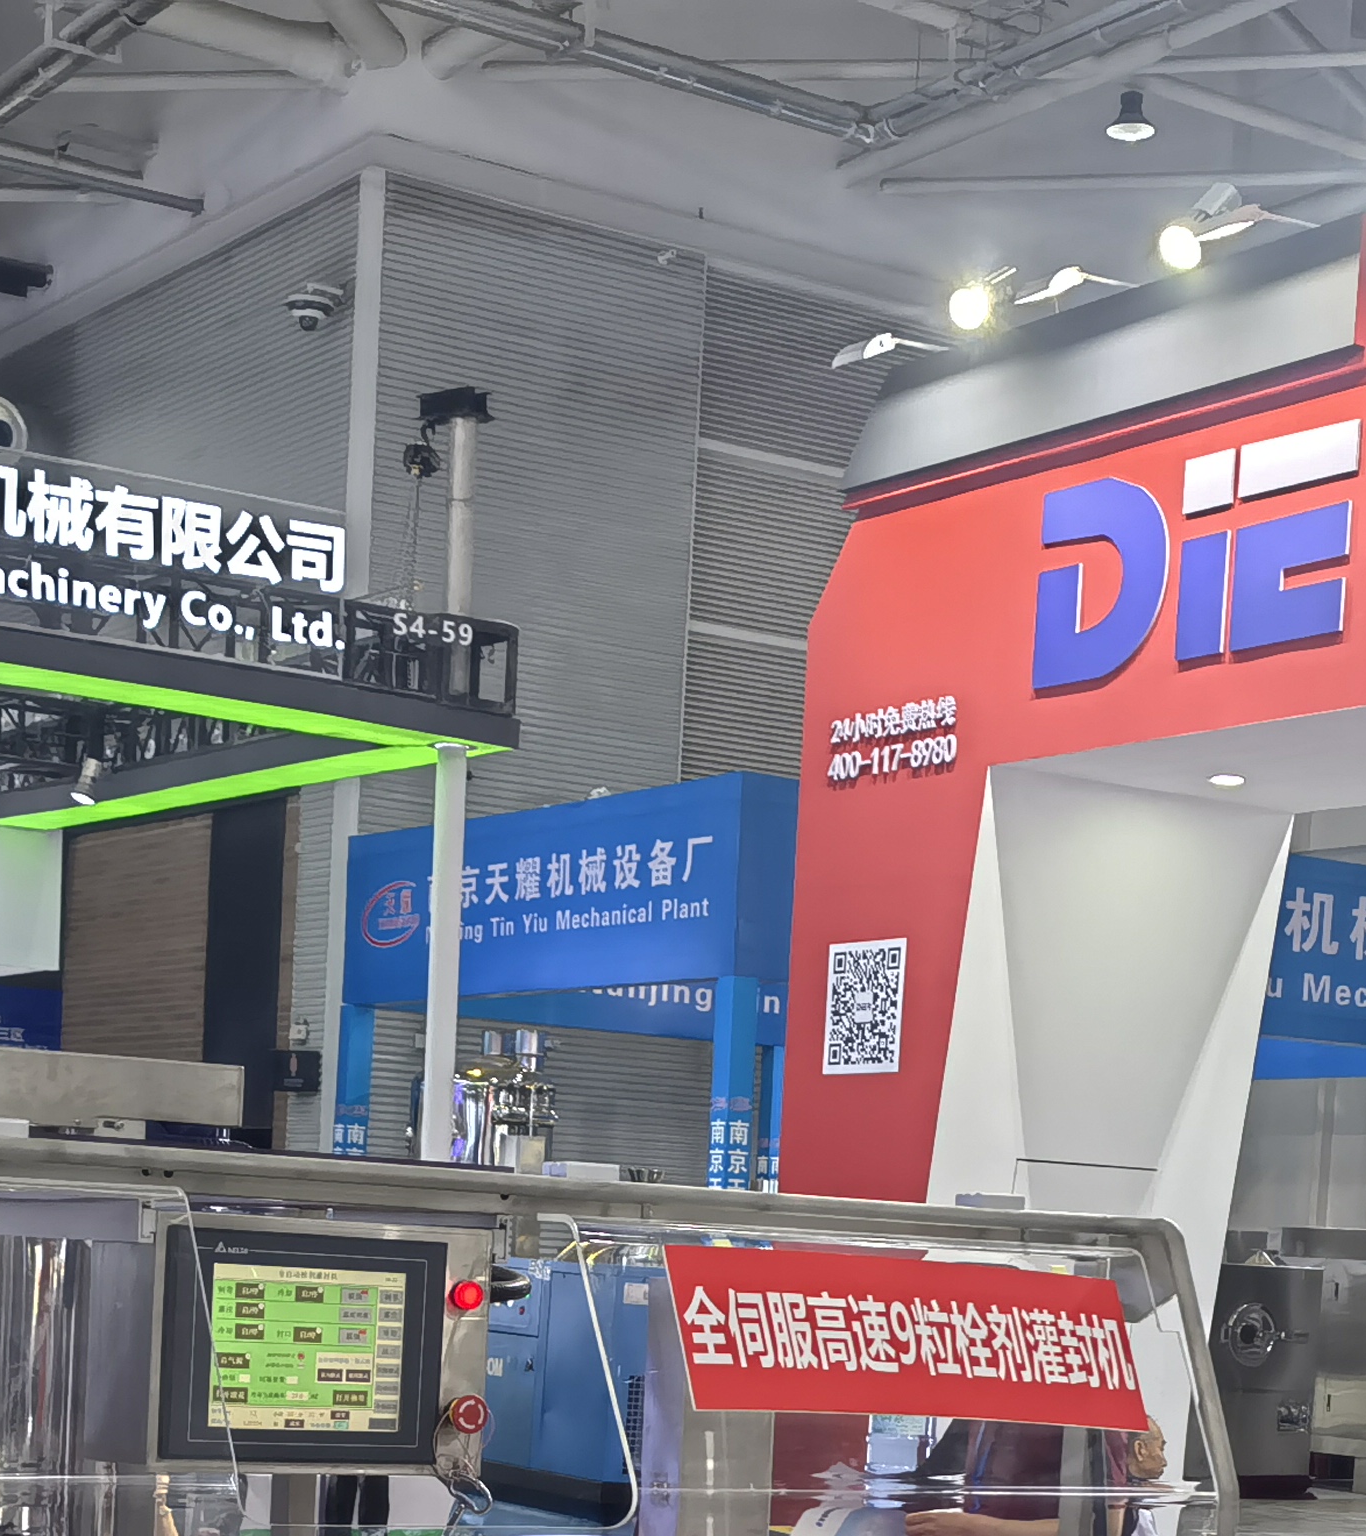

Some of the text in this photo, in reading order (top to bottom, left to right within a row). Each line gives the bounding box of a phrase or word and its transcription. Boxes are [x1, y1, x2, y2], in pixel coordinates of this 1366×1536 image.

[181, 590, 256, 641] Co.,
[272, 606, 346, 650] Ltd.
[392, 613, 474, 647] S4-59
[827, 734, 957, 780] 400-117-8980
[427, 835, 714, 912] 京天耀机械设备厂
[491, 917, 515, 938] Tin
[522, 913, 548, 934] Yiu
[555, 900, 654, 931] Mechanical
[661, 898, 711, 922] Plant
[683, 1285, 1136, 1391] 全伺服高速9粒栓剂灌封机
